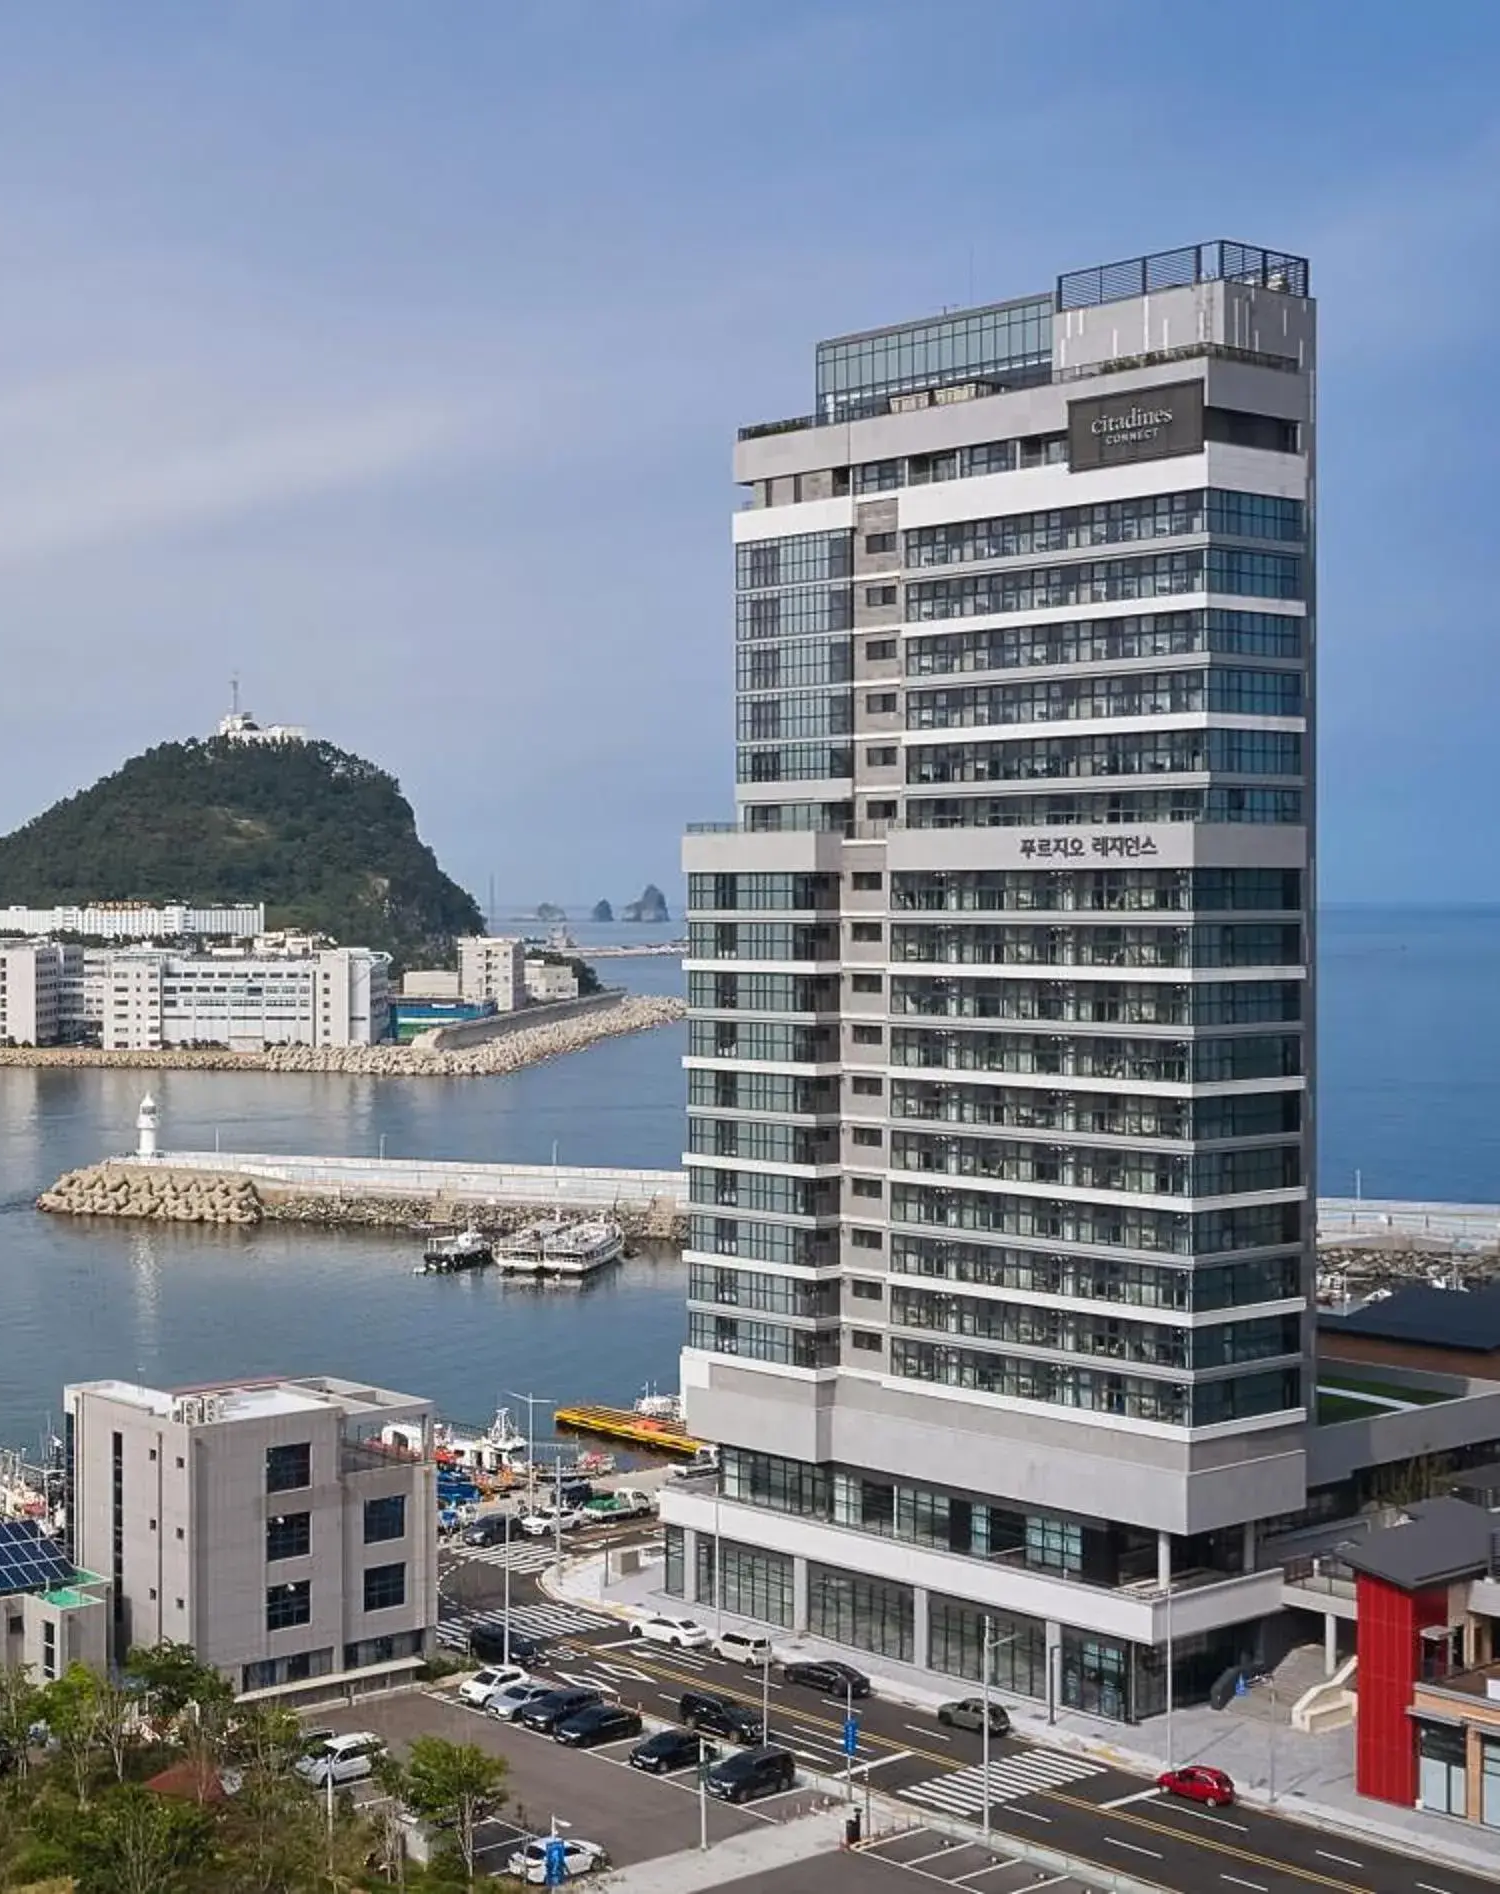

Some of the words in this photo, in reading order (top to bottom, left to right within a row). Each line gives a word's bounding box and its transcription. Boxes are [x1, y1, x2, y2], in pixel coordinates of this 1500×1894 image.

[1091, 407, 1173, 433] citadines
[1106, 428, 1159, 445] CONNECT
[1020, 837, 1085, 859] 푸르지오
[1092, 835, 1158, 857] 레지던스
